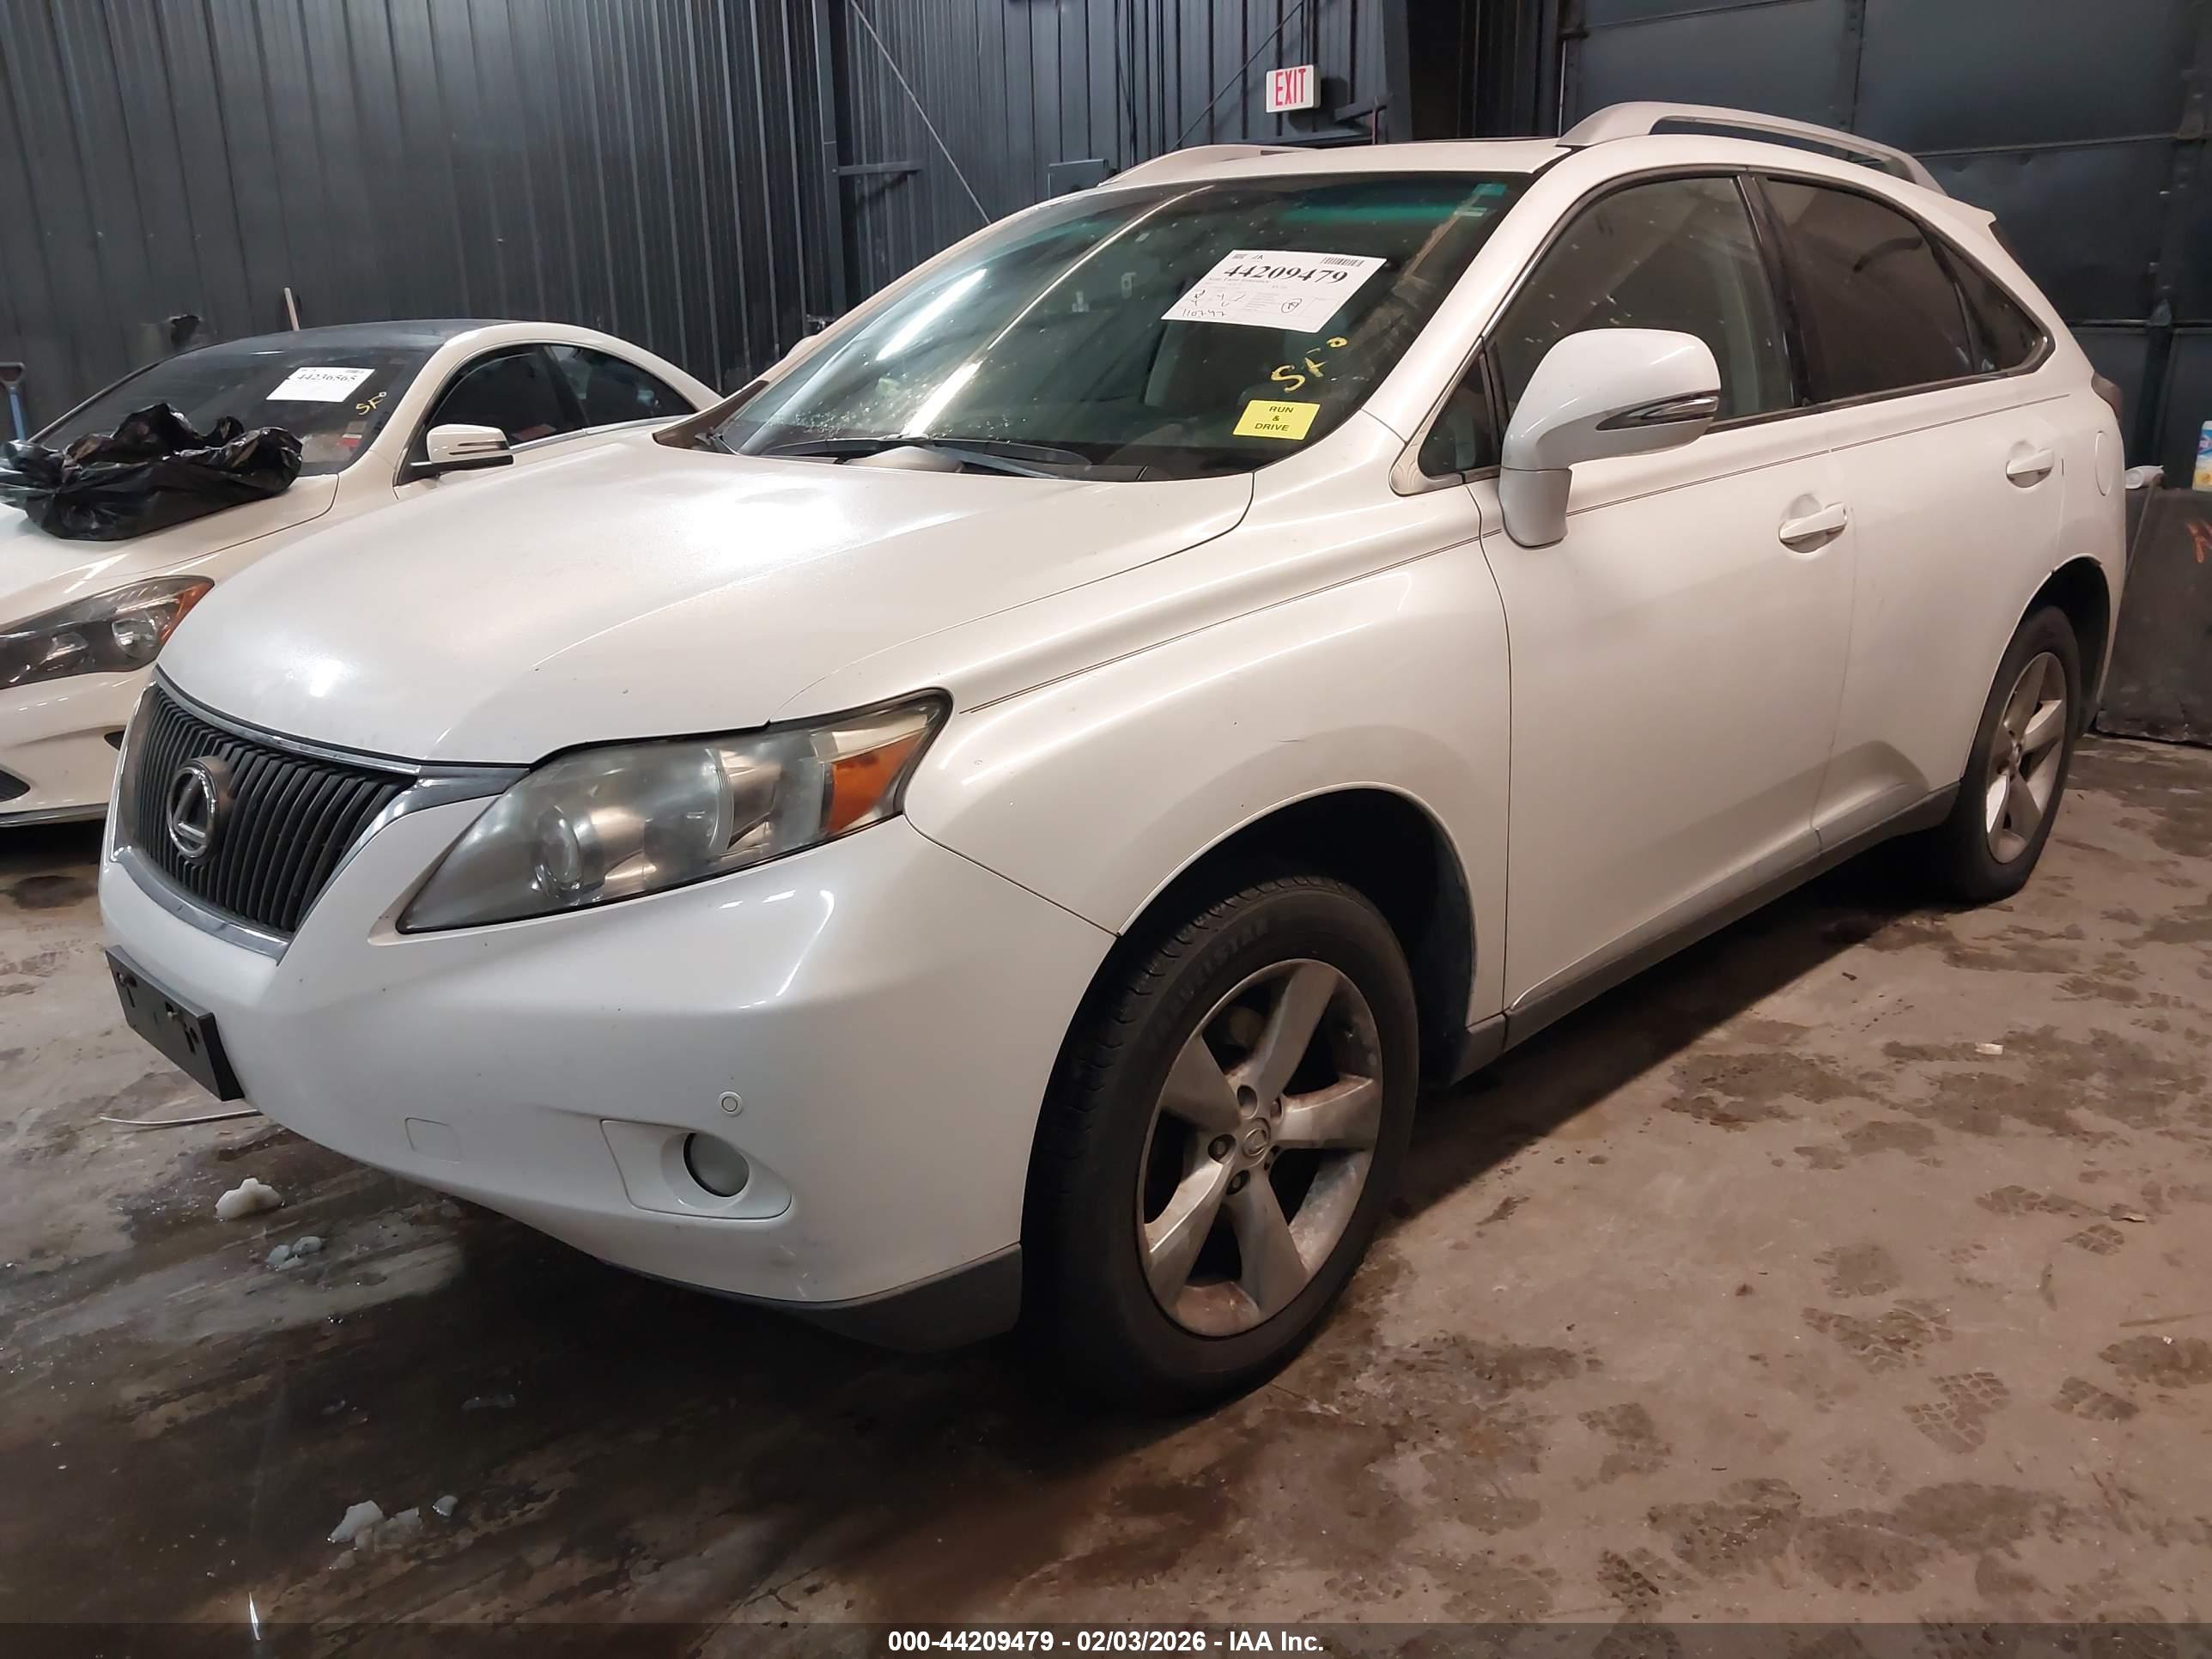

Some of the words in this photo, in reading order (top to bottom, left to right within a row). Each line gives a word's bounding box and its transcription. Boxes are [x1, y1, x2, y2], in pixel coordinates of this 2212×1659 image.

[1275, 69, 1306, 106] EXIT
[1223, 264, 1348, 284] 44209479
[1268, 405, 1294, 414] RUN
[1254, 422, 1290, 432] DRIVE
